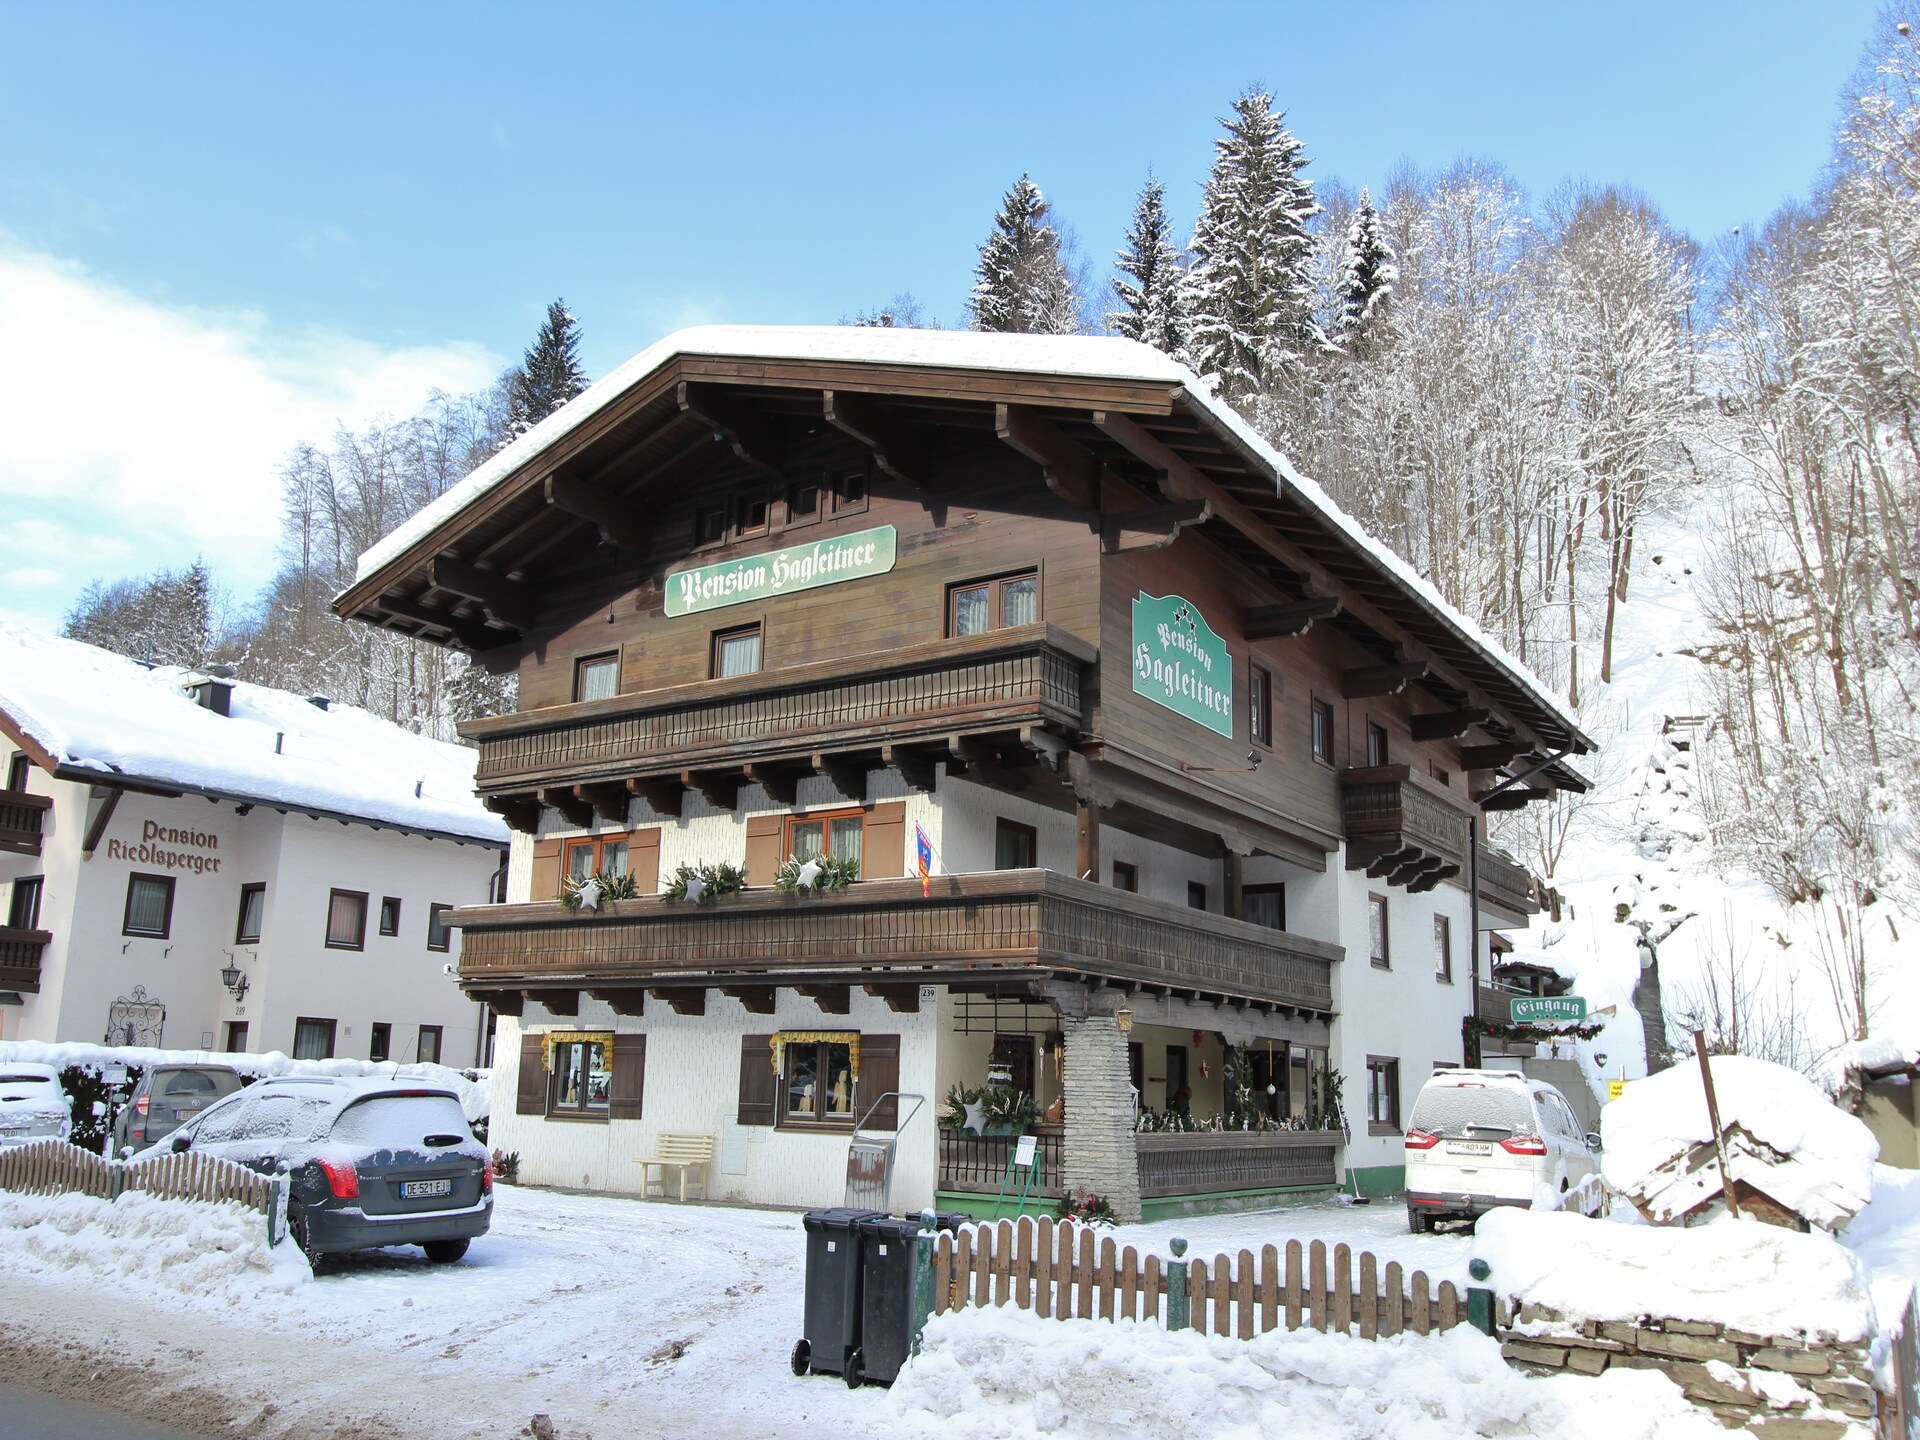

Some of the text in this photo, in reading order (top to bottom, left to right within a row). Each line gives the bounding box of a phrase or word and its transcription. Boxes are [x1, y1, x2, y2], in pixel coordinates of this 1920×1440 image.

[679, 541, 876, 612] Pension Hagleitner
[1156, 622, 1213, 672] Pension
[1135, 642, 1231, 717] Hagleitner
[142, 819, 219, 850] Pension
[107, 838, 222, 876] Riedlsperger
[922, 988, 935, 997] 239
[1516, 999, 1580, 1016] Eingang
[406, 1180, 447, 1195] DE-521-EJ
